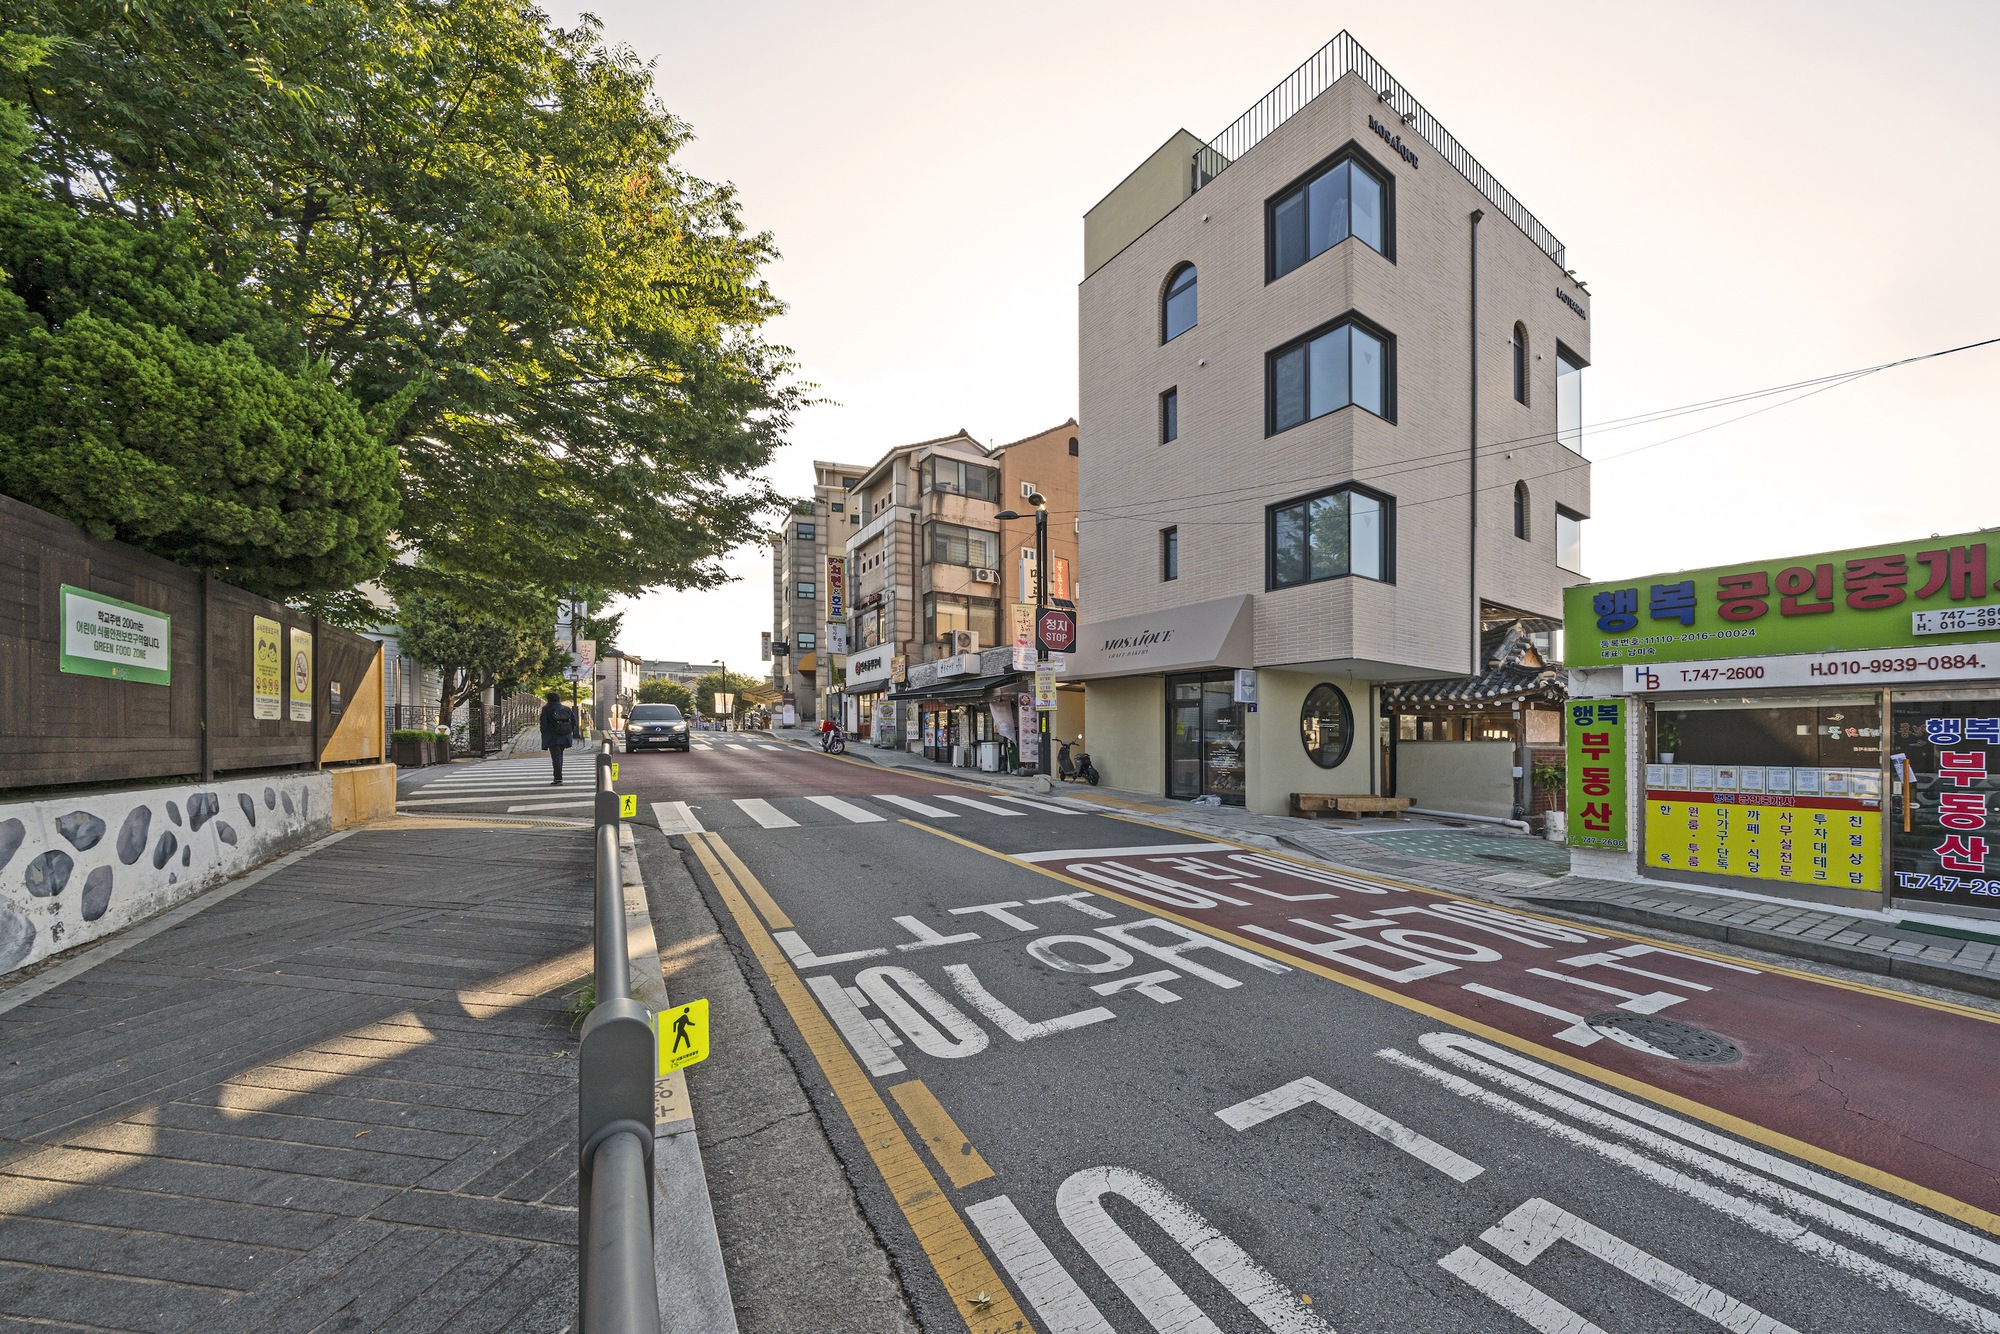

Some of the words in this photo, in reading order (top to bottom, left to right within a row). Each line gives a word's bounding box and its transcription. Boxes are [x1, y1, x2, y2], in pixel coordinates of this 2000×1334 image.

[1593, 580, 1696, 633] 행복
[1716, 543, 2000, 622] 공인중개
[97, 610, 121, 627] 학교주변
[122, 617, 144, 632] 200m는
[1917, 613, 1932, 622] T.
[1940, 607, 2000, 620] 747-26
[1917, 622, 1932, 631] H.
[1940, 617, 2000, 630] 010-99
[76, 620, 97, 636] 어린이
[1046, 619, 1068, 632] 정지
[1046, 633, 1068, 642] STOP
[1100, 629, 1175, 651] MOSAÏQUE
[93, 640, 114, 654] GREEN
[115, 644, 131, 657] FOOD
[132, 647, 147, 660] ZONE
[1572, 705, 1618, 726] 행복
[1925, 718, 2000, 745] 행복
[1580, 732, 1612, 832] 부동산
[1713, 793, 1736, 804] 행복
[1738, 795, 1796, 808] 공인중개사
[1933, 751, 1989, 873] 부동산
[1582, 836, 1625, 847] 747-2600
[1779, 811, 1794, 877] 사무실전문
[1848, 815, 1864, 885] 친절상담
